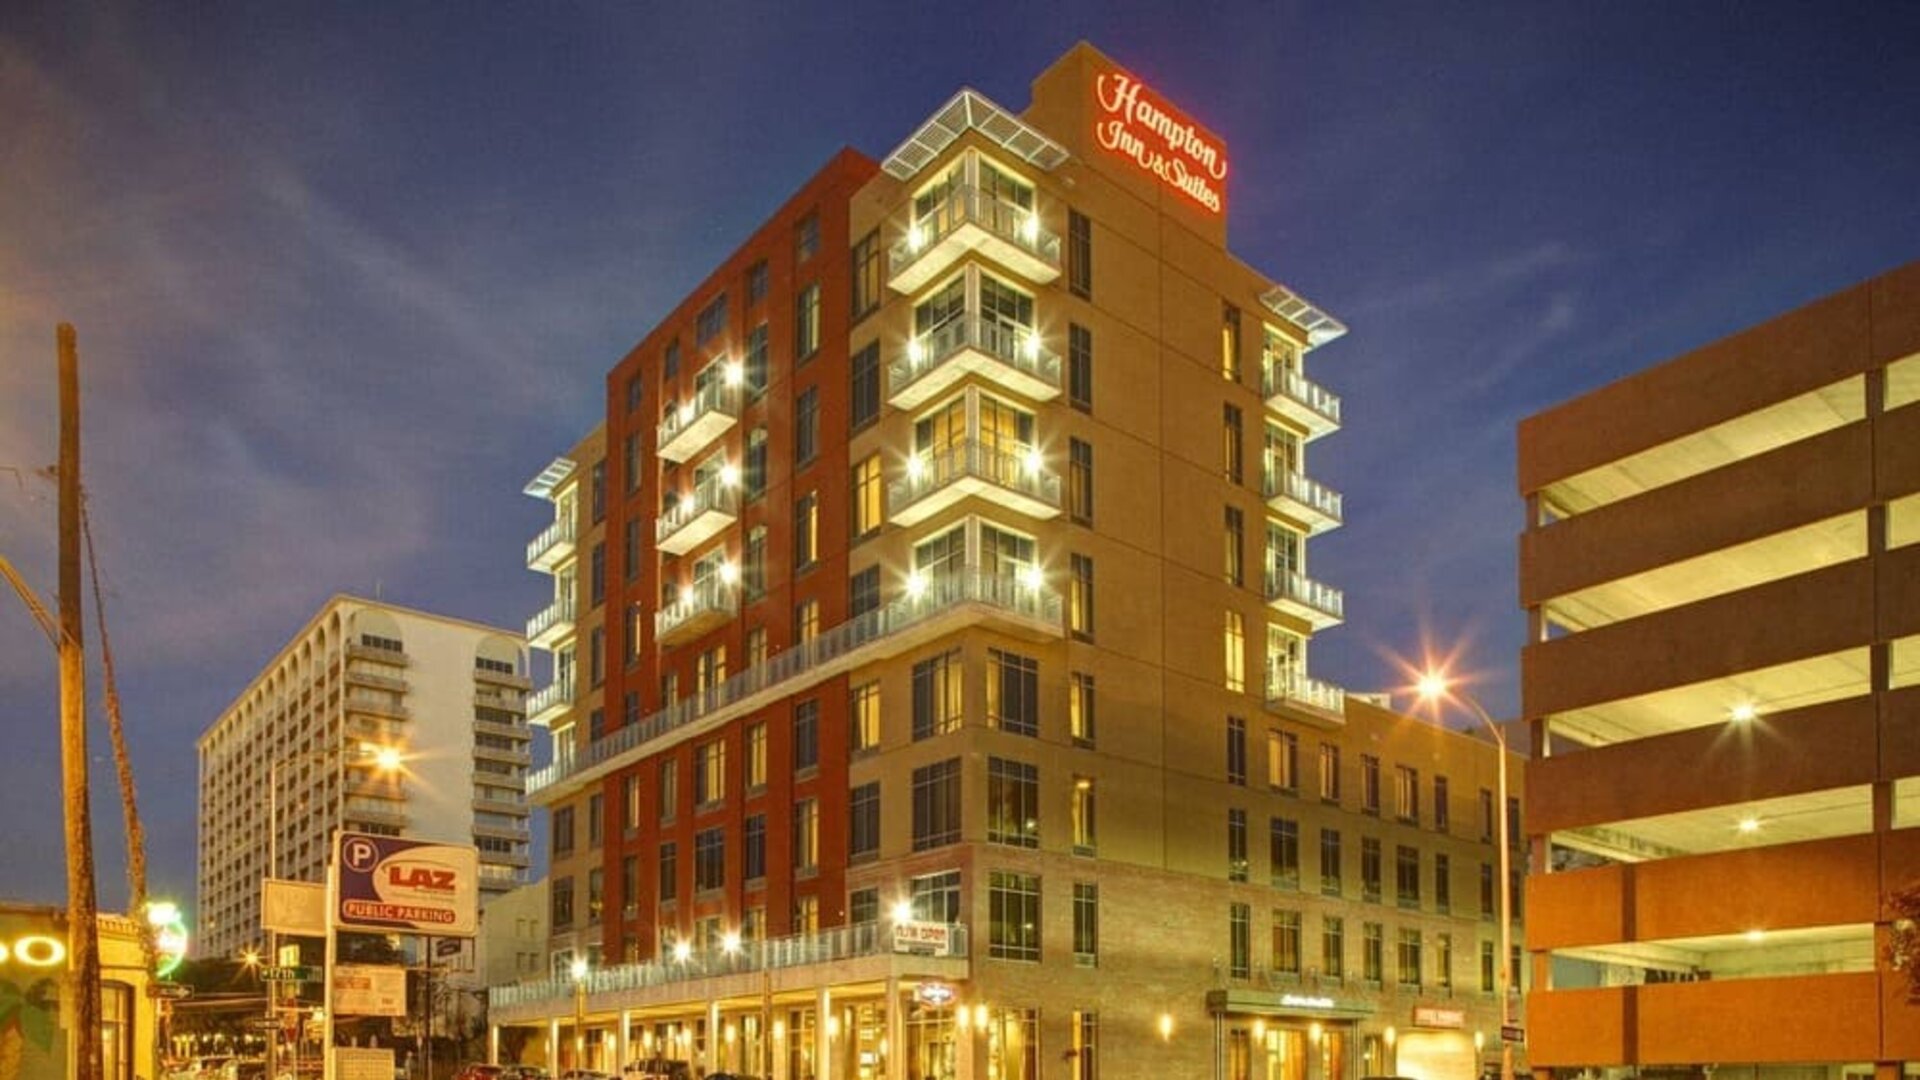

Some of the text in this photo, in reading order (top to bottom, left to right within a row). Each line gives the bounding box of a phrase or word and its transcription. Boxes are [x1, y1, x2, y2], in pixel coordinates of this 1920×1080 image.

[1097, 73, 1227, 180] Hampton
[1097, 120, 1220, 213] Inn & Suites
[352, 843, 372, 867] P
[389, 866, 456, 891] LAZ
[349, 902, 452, 923] PUBLIC PARKING
